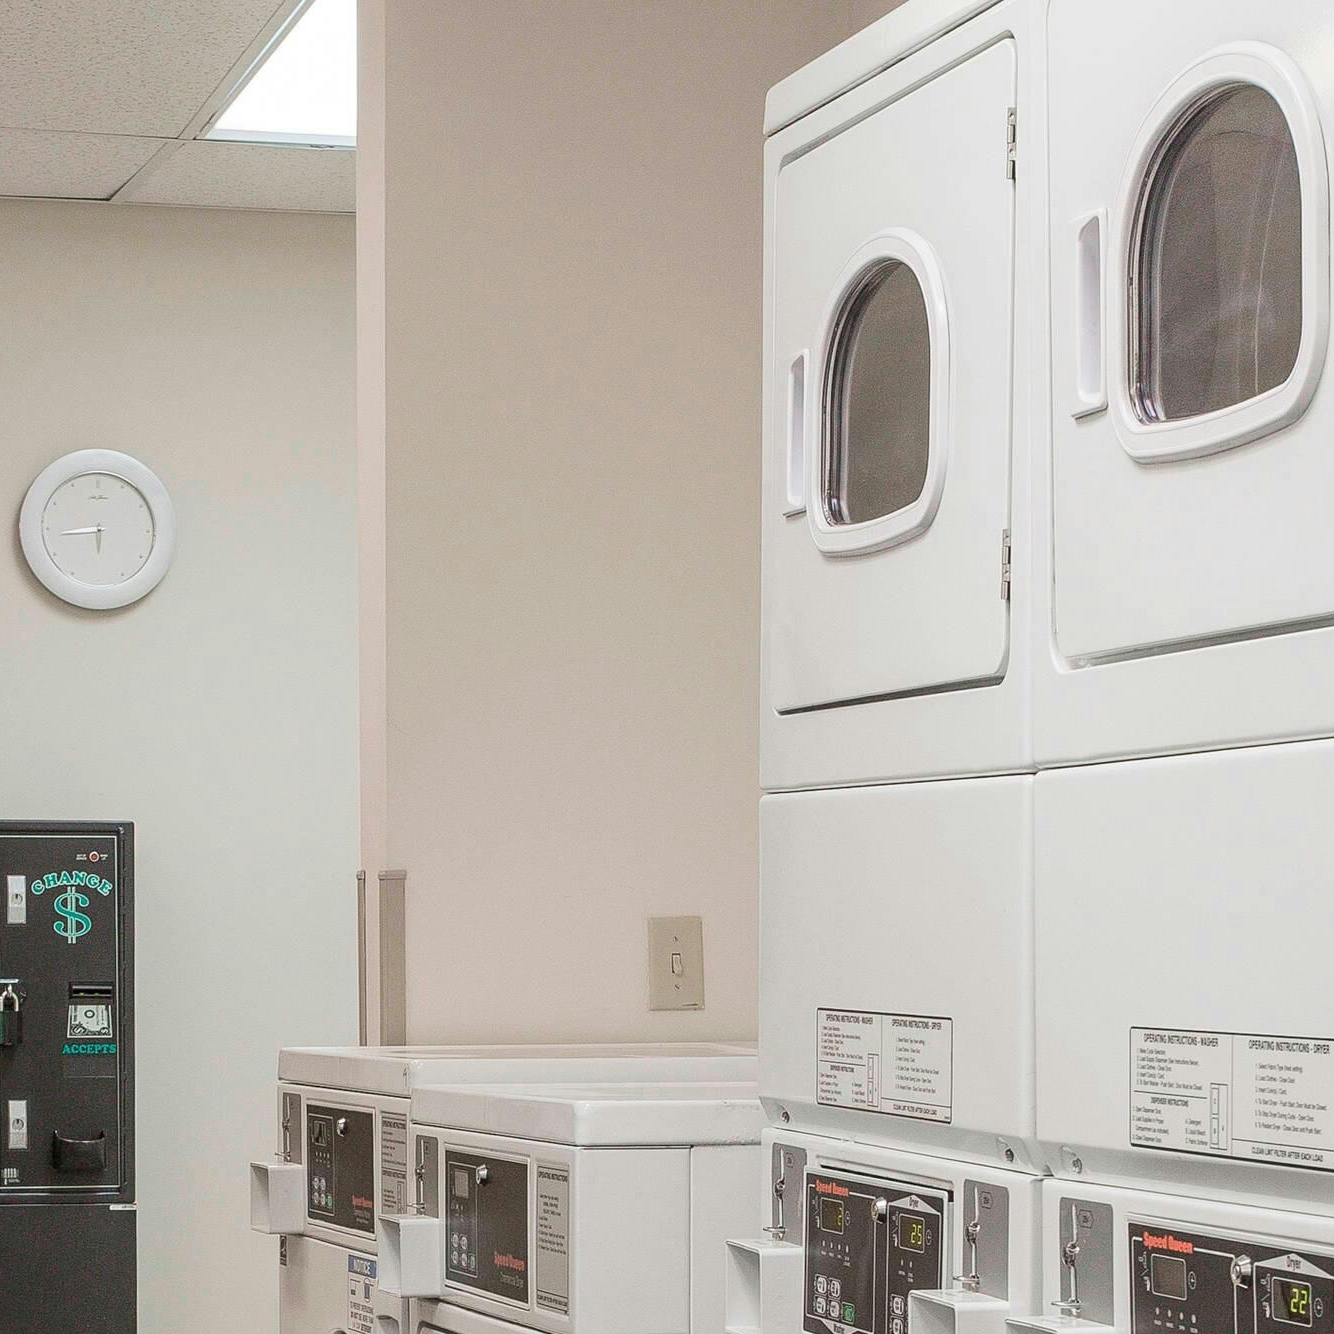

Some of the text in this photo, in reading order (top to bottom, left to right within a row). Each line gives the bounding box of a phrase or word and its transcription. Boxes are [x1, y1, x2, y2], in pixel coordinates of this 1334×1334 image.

[31, 871, 113, 896] CHANGE
[54, 886, 92, 944] $
[1144, 1033, 1166, 1044] OPERATING
[1167, 1035, 1197, 1046] INSTRUCTIONS
[1249, 1040, 1330, 1054] OPERATING INSTRUCTIONS DRYER
[62, 1044, 116, 1054] ACCEPTS
[816, 1180, 832, 1193] Speed
[911, 1224, 922, 1245] 25
[1143, 1231, 1193, 1254] Speed Queen
[1286, 1255, 1302, 1271] Dryer
[1290, 1288, 1308, 1314] 22
